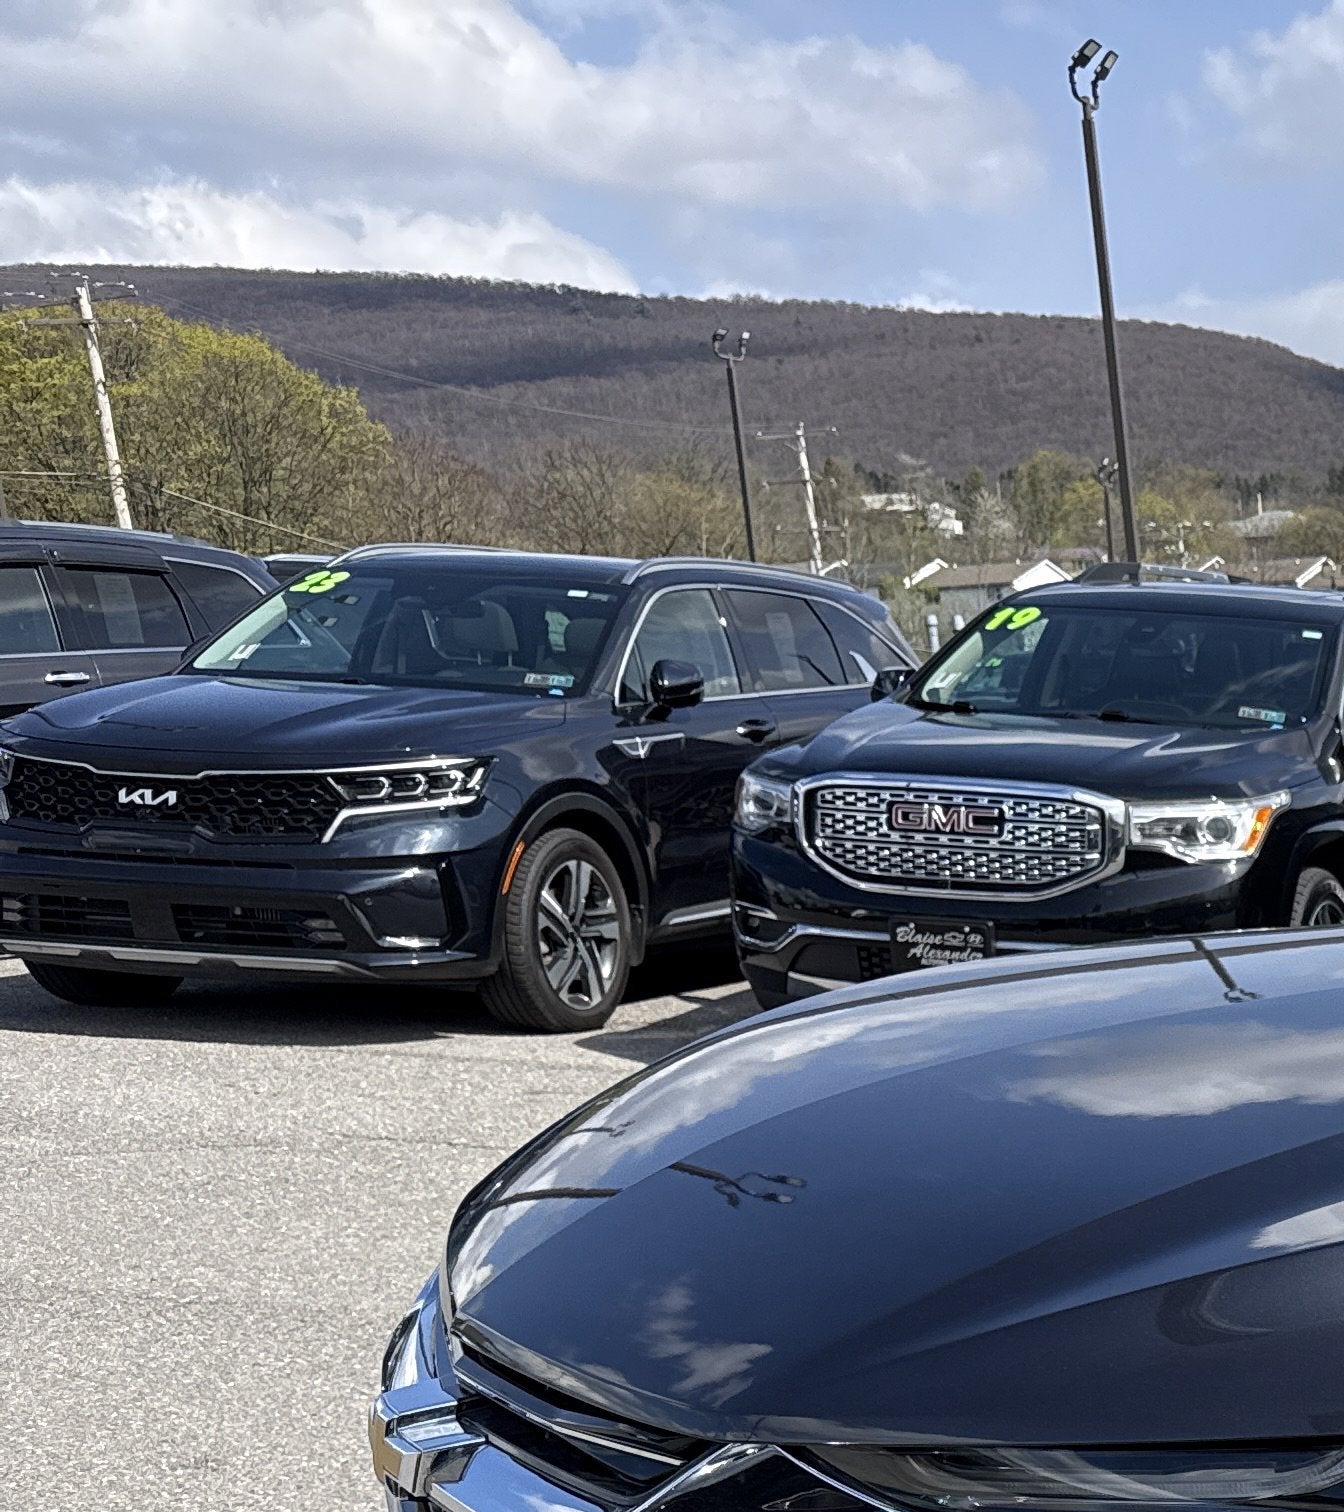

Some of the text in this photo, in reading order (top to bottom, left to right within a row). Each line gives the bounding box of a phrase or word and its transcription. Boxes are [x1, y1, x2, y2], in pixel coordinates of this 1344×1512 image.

[984, 607, 1041, 630] 19
[892, 803, 999, 834] GMC
[896, 926, 944, 945] Blaise
